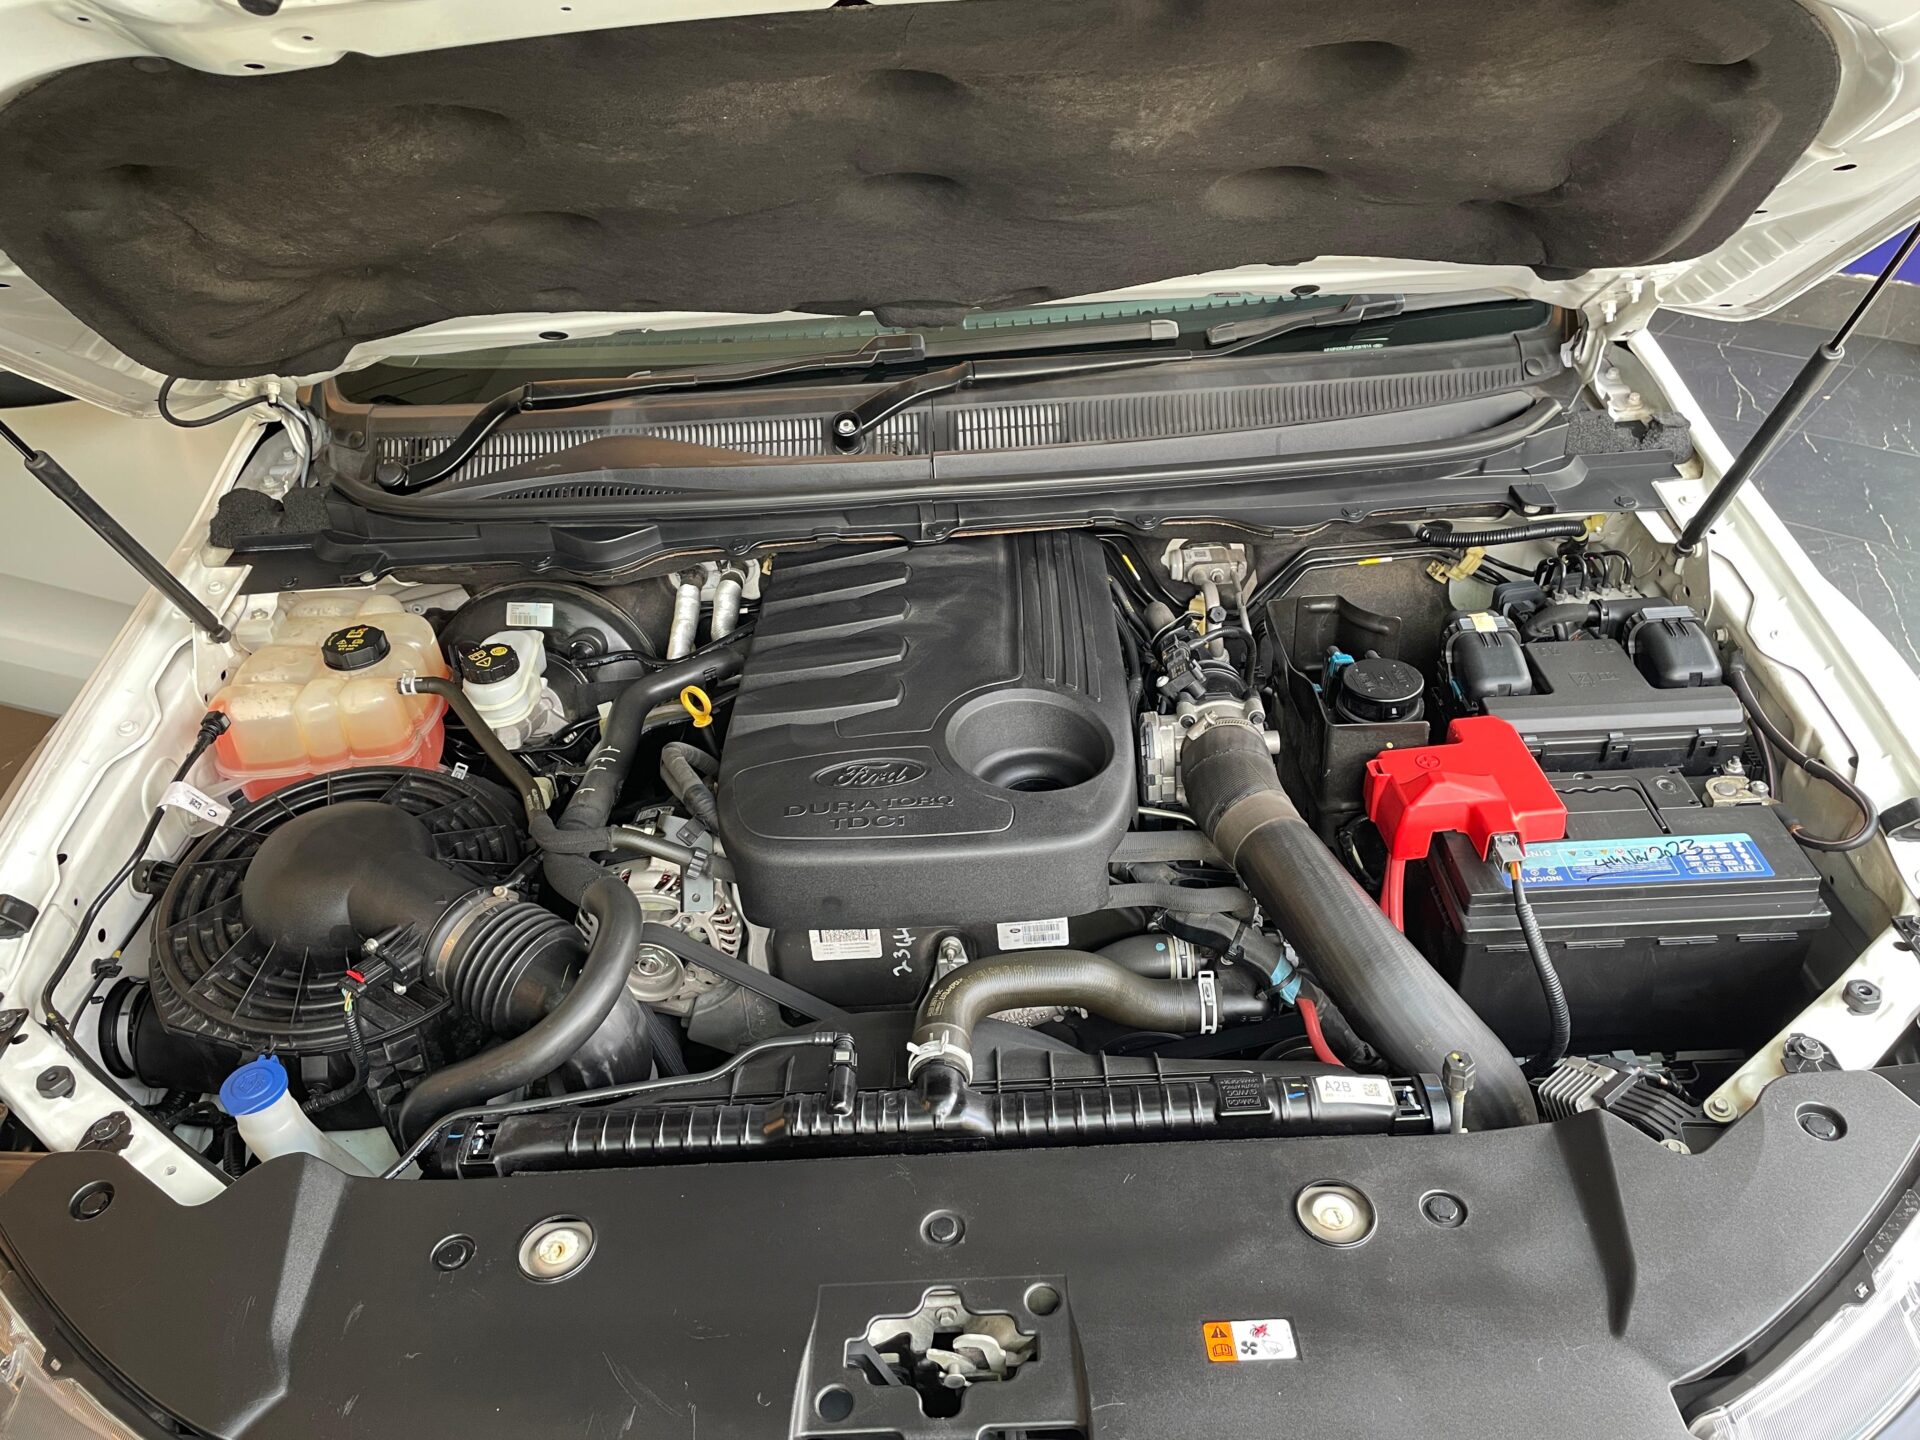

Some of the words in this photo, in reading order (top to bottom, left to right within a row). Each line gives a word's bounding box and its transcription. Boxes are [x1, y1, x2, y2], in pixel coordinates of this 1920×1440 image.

[832, 761, 910, 787] Ford
[783, 795, 955, 819] DURATORQ
[829, 814, 906, 831] TDCi
[1622, 850, 1650, 865] Nov
[1648, 839, 1704, 860] 2023
[1325, 1080, 1352, 1093] A2B
